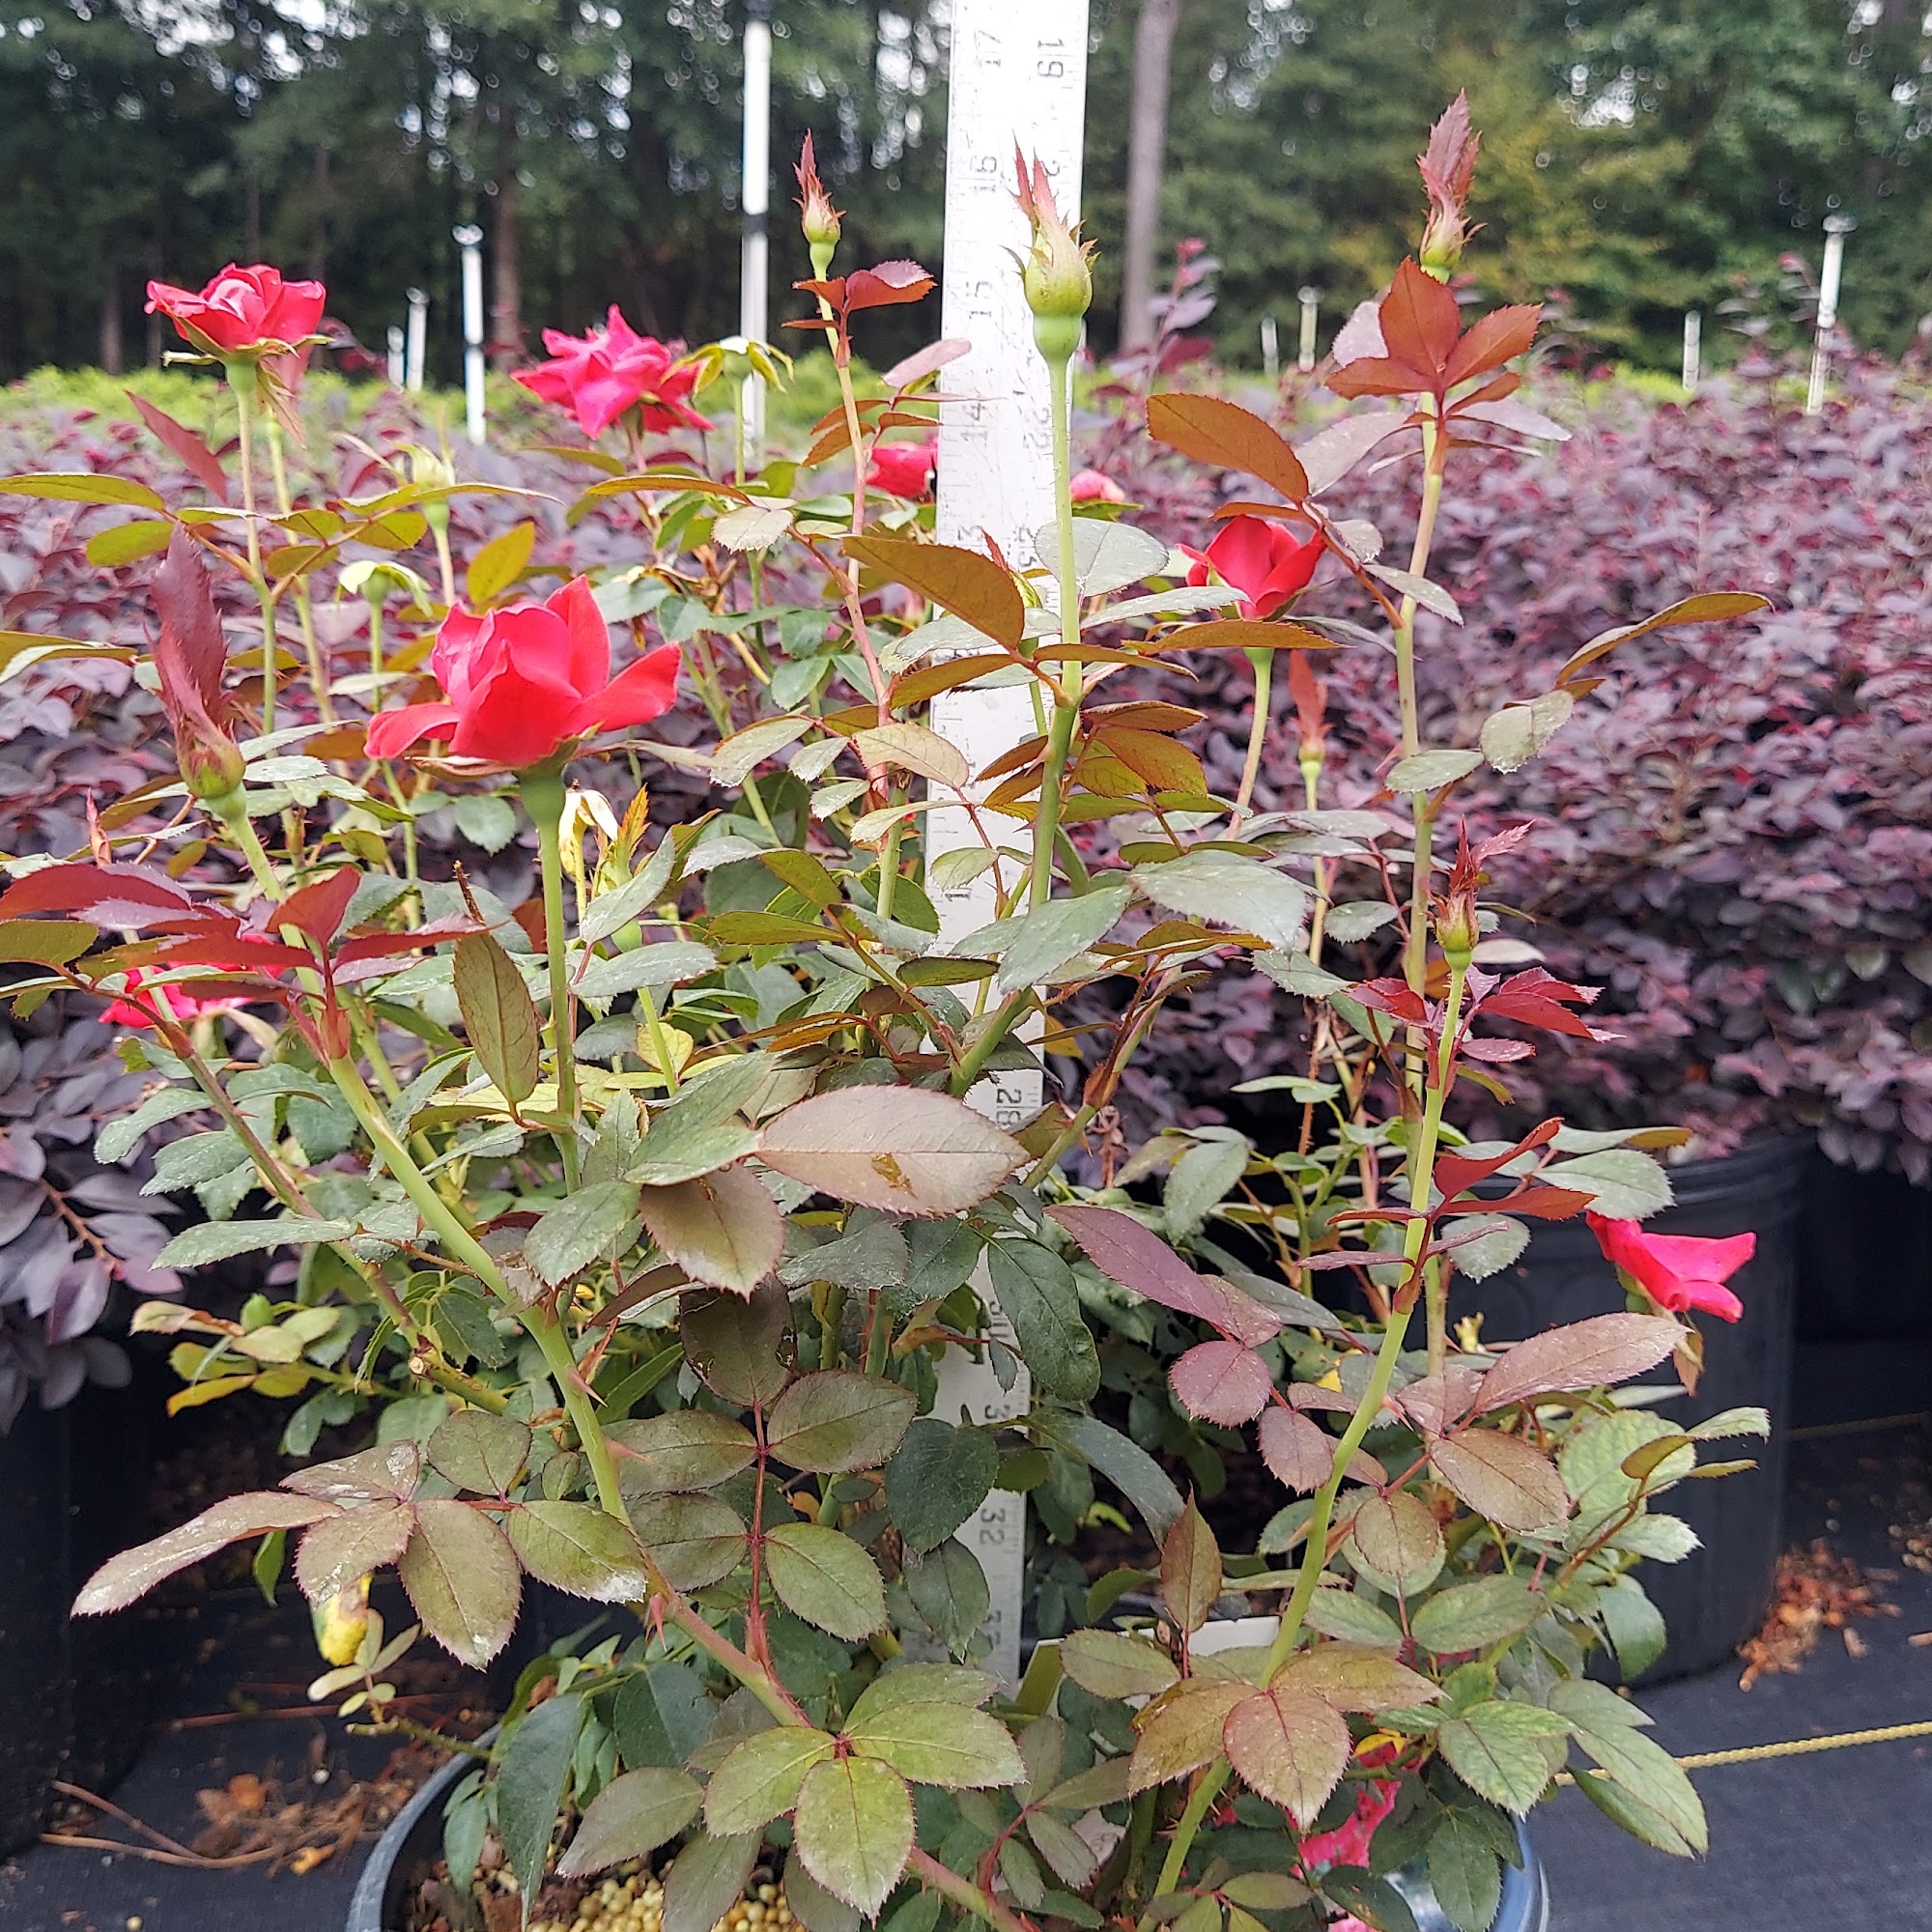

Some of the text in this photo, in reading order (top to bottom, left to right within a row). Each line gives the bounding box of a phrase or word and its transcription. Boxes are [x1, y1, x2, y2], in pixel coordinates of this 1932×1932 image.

[1037, 39, 1065, 78] 19
[996, 1089, 1022, 1127] 28
[979, 1507, 1005, 1547] 32
